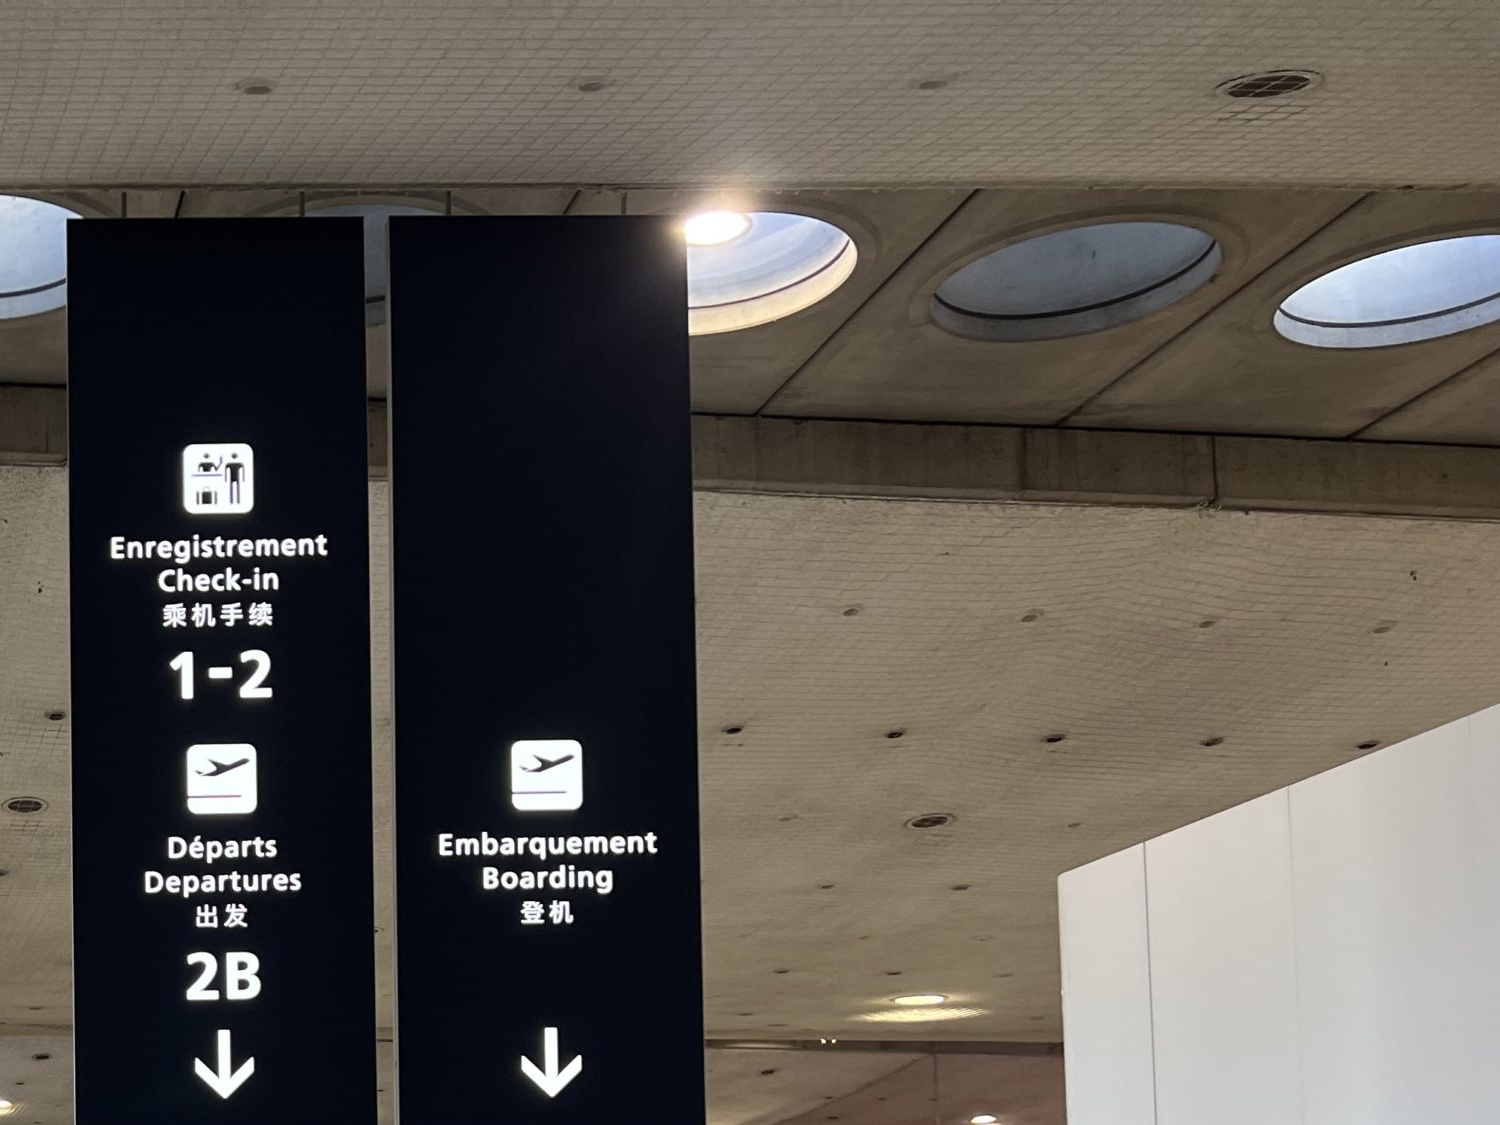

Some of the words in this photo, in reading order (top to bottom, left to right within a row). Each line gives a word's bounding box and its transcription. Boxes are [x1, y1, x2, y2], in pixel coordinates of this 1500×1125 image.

[110, 534, 328, 561] Enregistrement
[157, 567, 280, 592] Check-in
[162, 602, 274, 628] 乘机手续
[169, 650, 273, 699] 1-2
[167, 835, 278, 862] Départs
[438, 831, 658, 860] Embarquement
[144, 870, 302, 897] Departures
[482, 865, 614, 894] Boarding
[195, 904, 248, 928] 出发
[520, 900, 574, 925] 登机
[185, 952, 262, 1001] 2B
